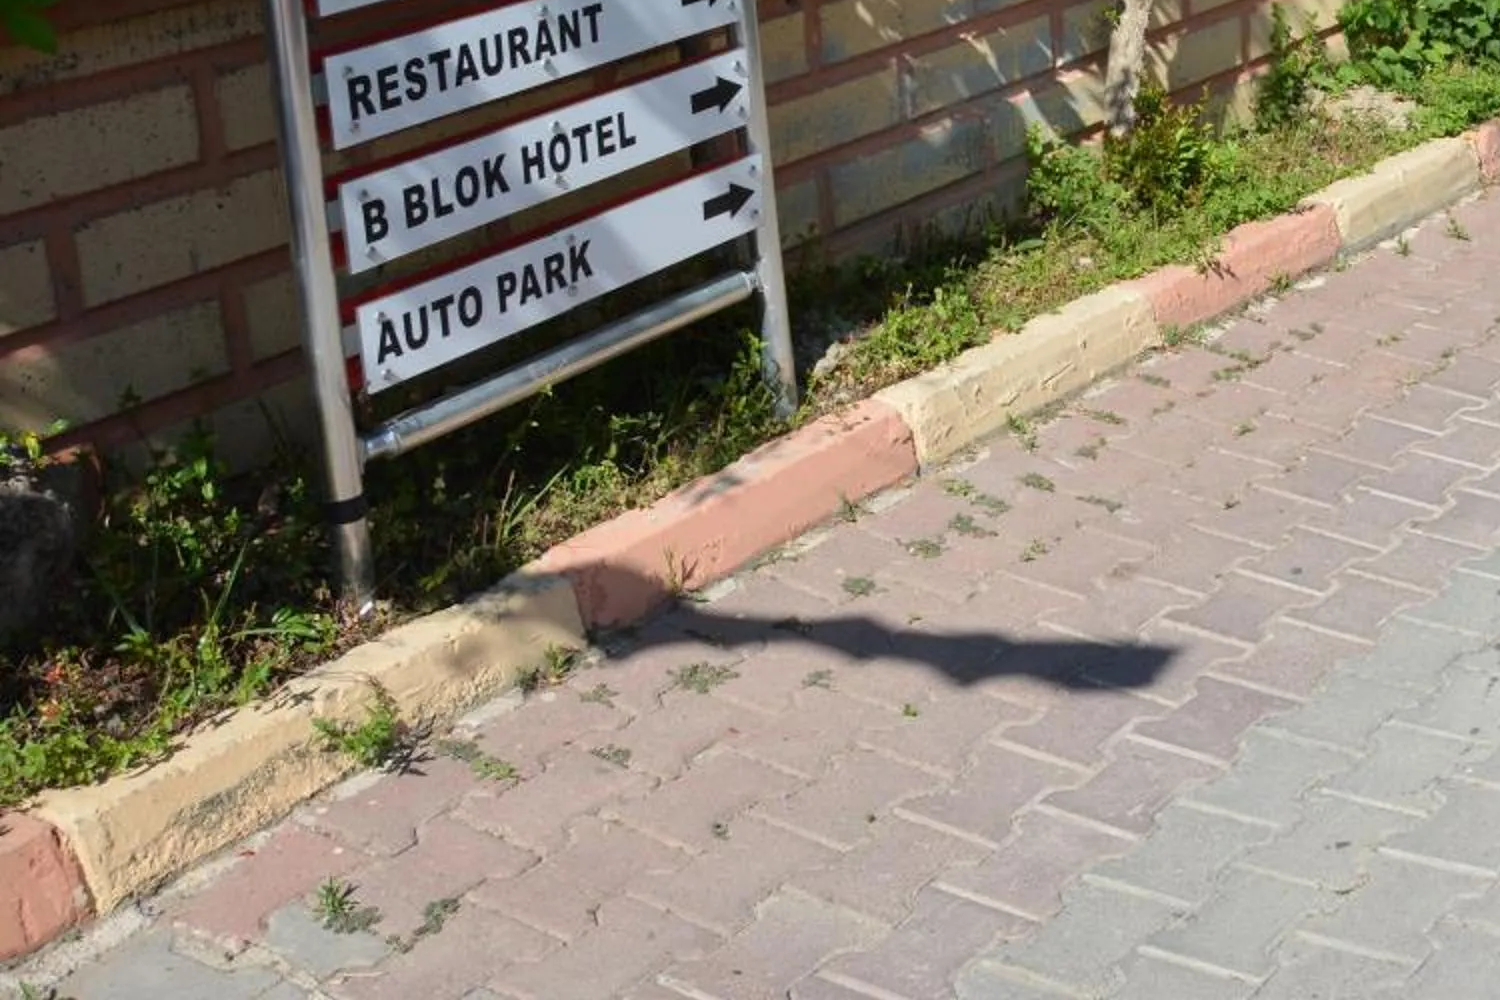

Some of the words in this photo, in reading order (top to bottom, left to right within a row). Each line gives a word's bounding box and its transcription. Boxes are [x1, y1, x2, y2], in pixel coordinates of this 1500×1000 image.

[346, 3, 603, 121] RESTAURANT
[362, 197, 389, 244] B
[403, 153, 511, 229] BLOK
[521, 110, 637, 184] HOTEL
[376, 285, 483, 364] AUTO
[496, 239, 594, 313] PARK
